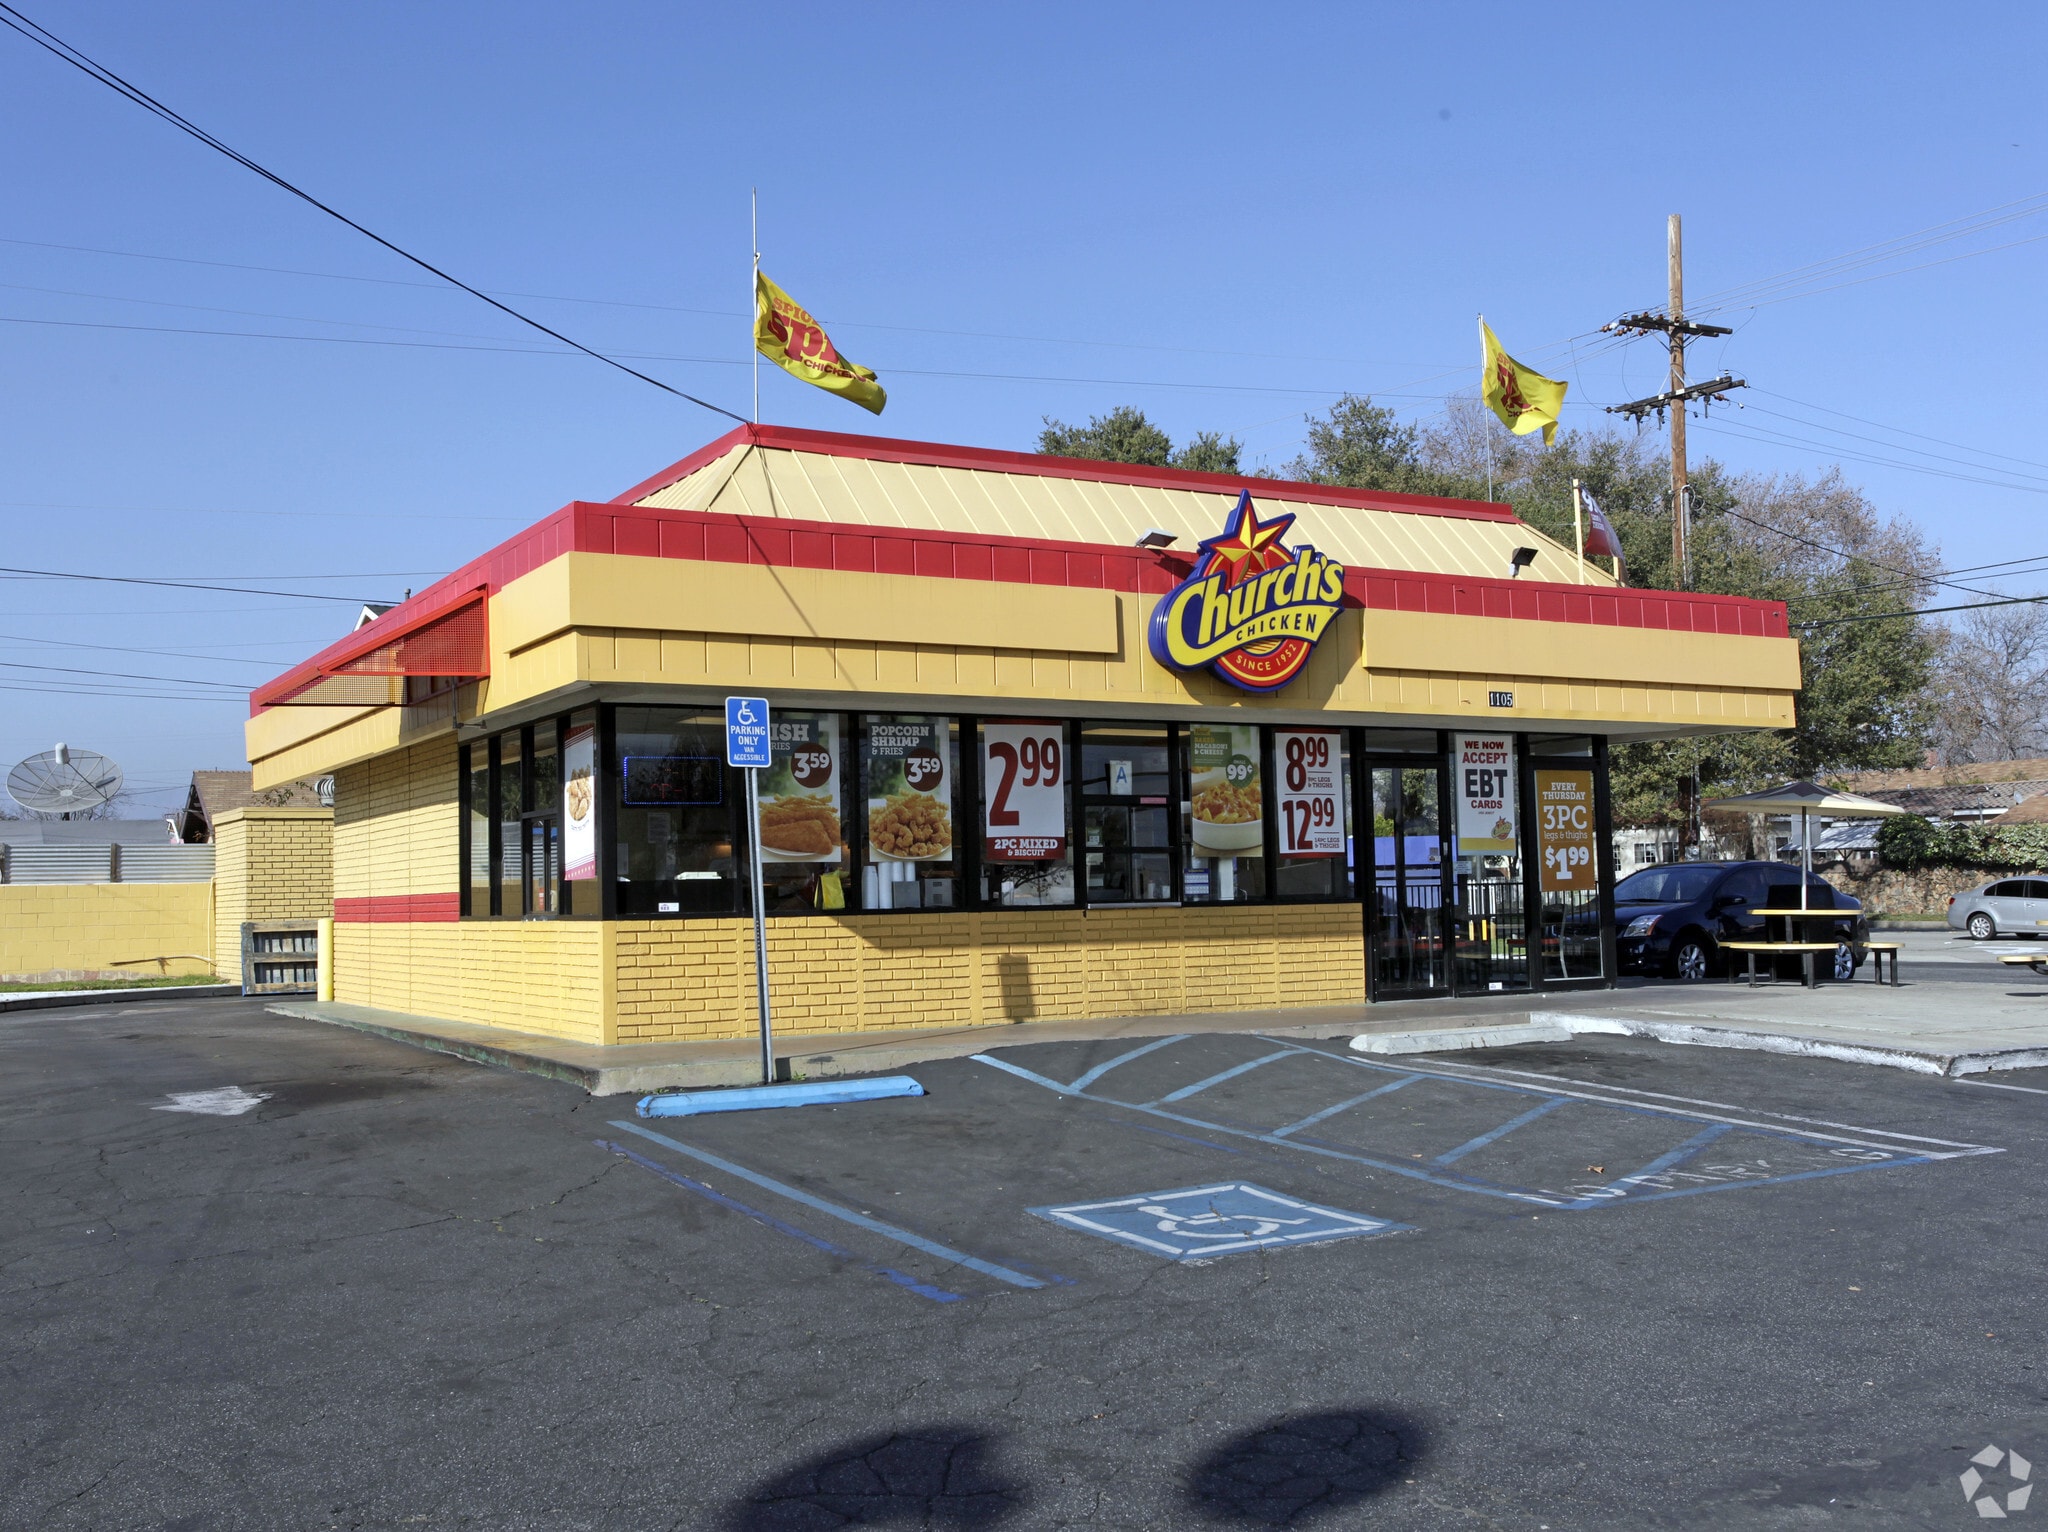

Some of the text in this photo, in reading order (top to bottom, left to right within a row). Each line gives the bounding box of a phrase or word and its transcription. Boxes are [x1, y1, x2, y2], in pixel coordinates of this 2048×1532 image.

[1166, 549, 1345, 667] Church's
[1236, 613, 1317, 641] CHICKEN
[1236, 643, 1297, 671] SINCE 1952
[1490, 692, 1513, 706] 1105
[730, 725, 766, 736] PARKING
[771, 723, 809, 741] ISH
[871, 726, 930, 736] POPCORN
[738, 735, 759, 746] ONLY
[771, 742, 791, 750] RIES
[871, 736, 920, 747] SHRIMP
[1464, 740, 1505, 750] WE NOW
[871, 747, 878, 755] &
[1462, 752, 1508, 764] ACCEPT
[1116, 766, 1127, 783] A
[1465, 769, 1508, 798] EBT
[1551, 782, 1577, 791] EVERY
[1542, 791, 1586, 800] THURSDAY
[1470, 800, 1503, 809] CARDS
[1543, 805, 1588, 829] 3PC
[1543, 831, 1559, 841] legs
[1566, 831, 1588, 841] thighs
[994, 839, 1058, 849] 2PC MIXED
[1014, 849, 1046, 857] BISCUIT
